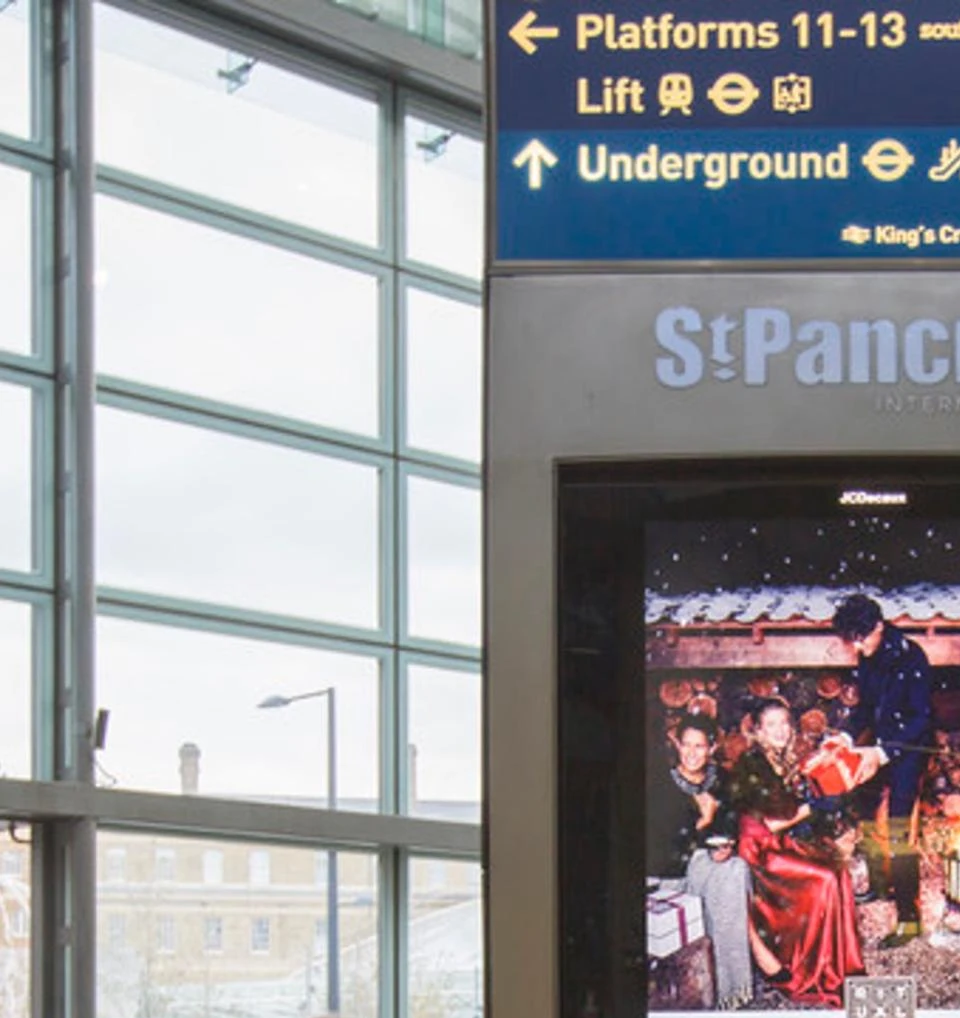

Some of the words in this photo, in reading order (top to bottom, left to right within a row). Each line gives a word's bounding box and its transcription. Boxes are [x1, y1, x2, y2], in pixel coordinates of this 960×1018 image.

[576, 13, 780, 50] Platforms
[791, 11, 907, 48] 11-13
[577, 78, 645, 115] Lift
[577, 143, 849, 190] Underground
[875, 225, 935, 248] King's
